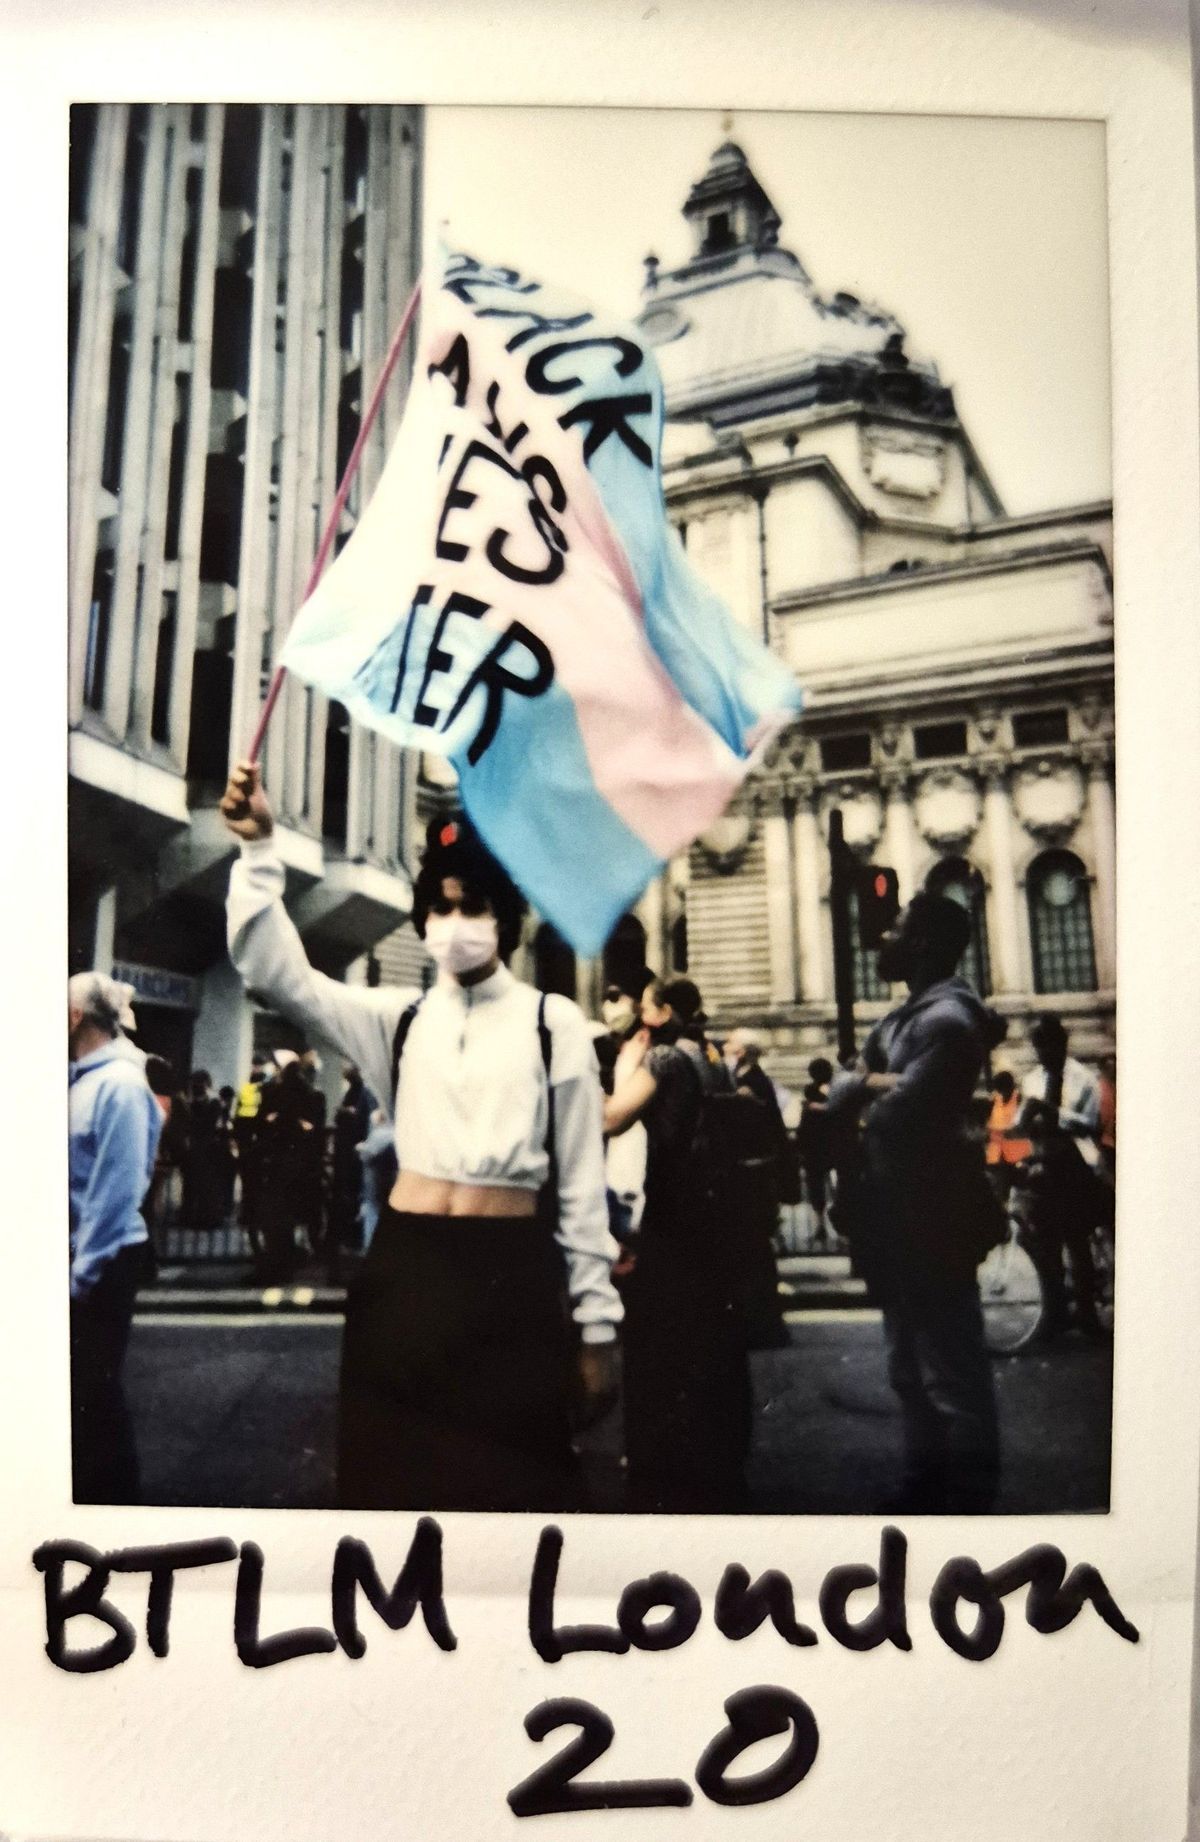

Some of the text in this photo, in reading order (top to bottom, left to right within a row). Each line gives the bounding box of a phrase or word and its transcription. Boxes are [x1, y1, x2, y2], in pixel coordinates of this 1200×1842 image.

[33, 1518, 1140, 1673] BTLM London
[507, 1688, 820, 1818] 20
